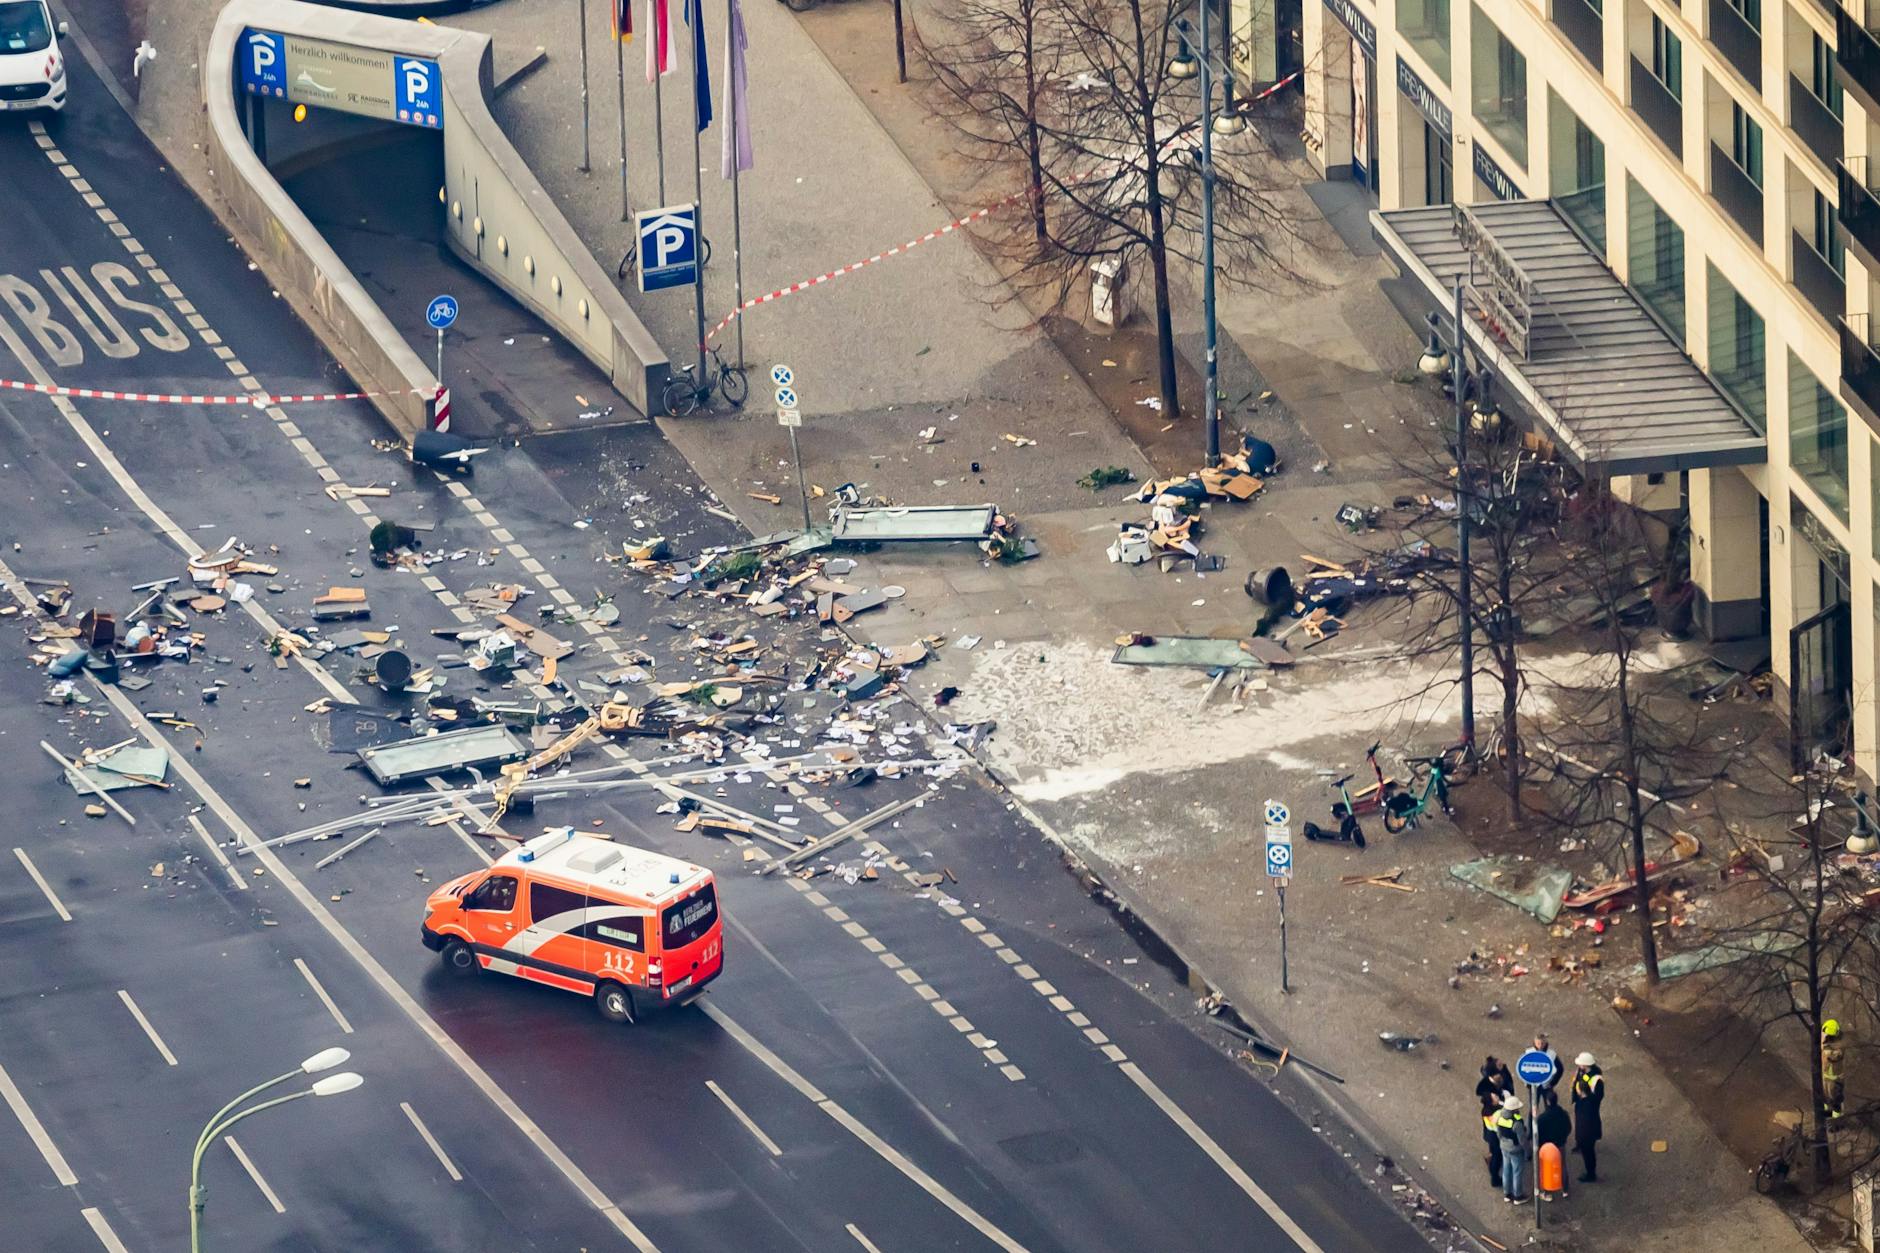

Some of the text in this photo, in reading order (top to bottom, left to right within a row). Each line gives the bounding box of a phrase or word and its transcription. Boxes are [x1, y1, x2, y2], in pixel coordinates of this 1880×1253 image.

[1334, 0, 1375, 50] EYWILLE
[253, 45, 275, 75] P
[290, 44, 327, 59] Herzlich
[330, 53, 389, 70] willkommen!
[263, 72, 277, 81] 24h
[406, 71, 428, 103] P
[416, 99, 429, 109] 24h
[656, 227, 685, 267] P
[0, 261, 190, 367] BUS
[604, 951, 634, 974] 112
[702, 940, 719, 964] 112
